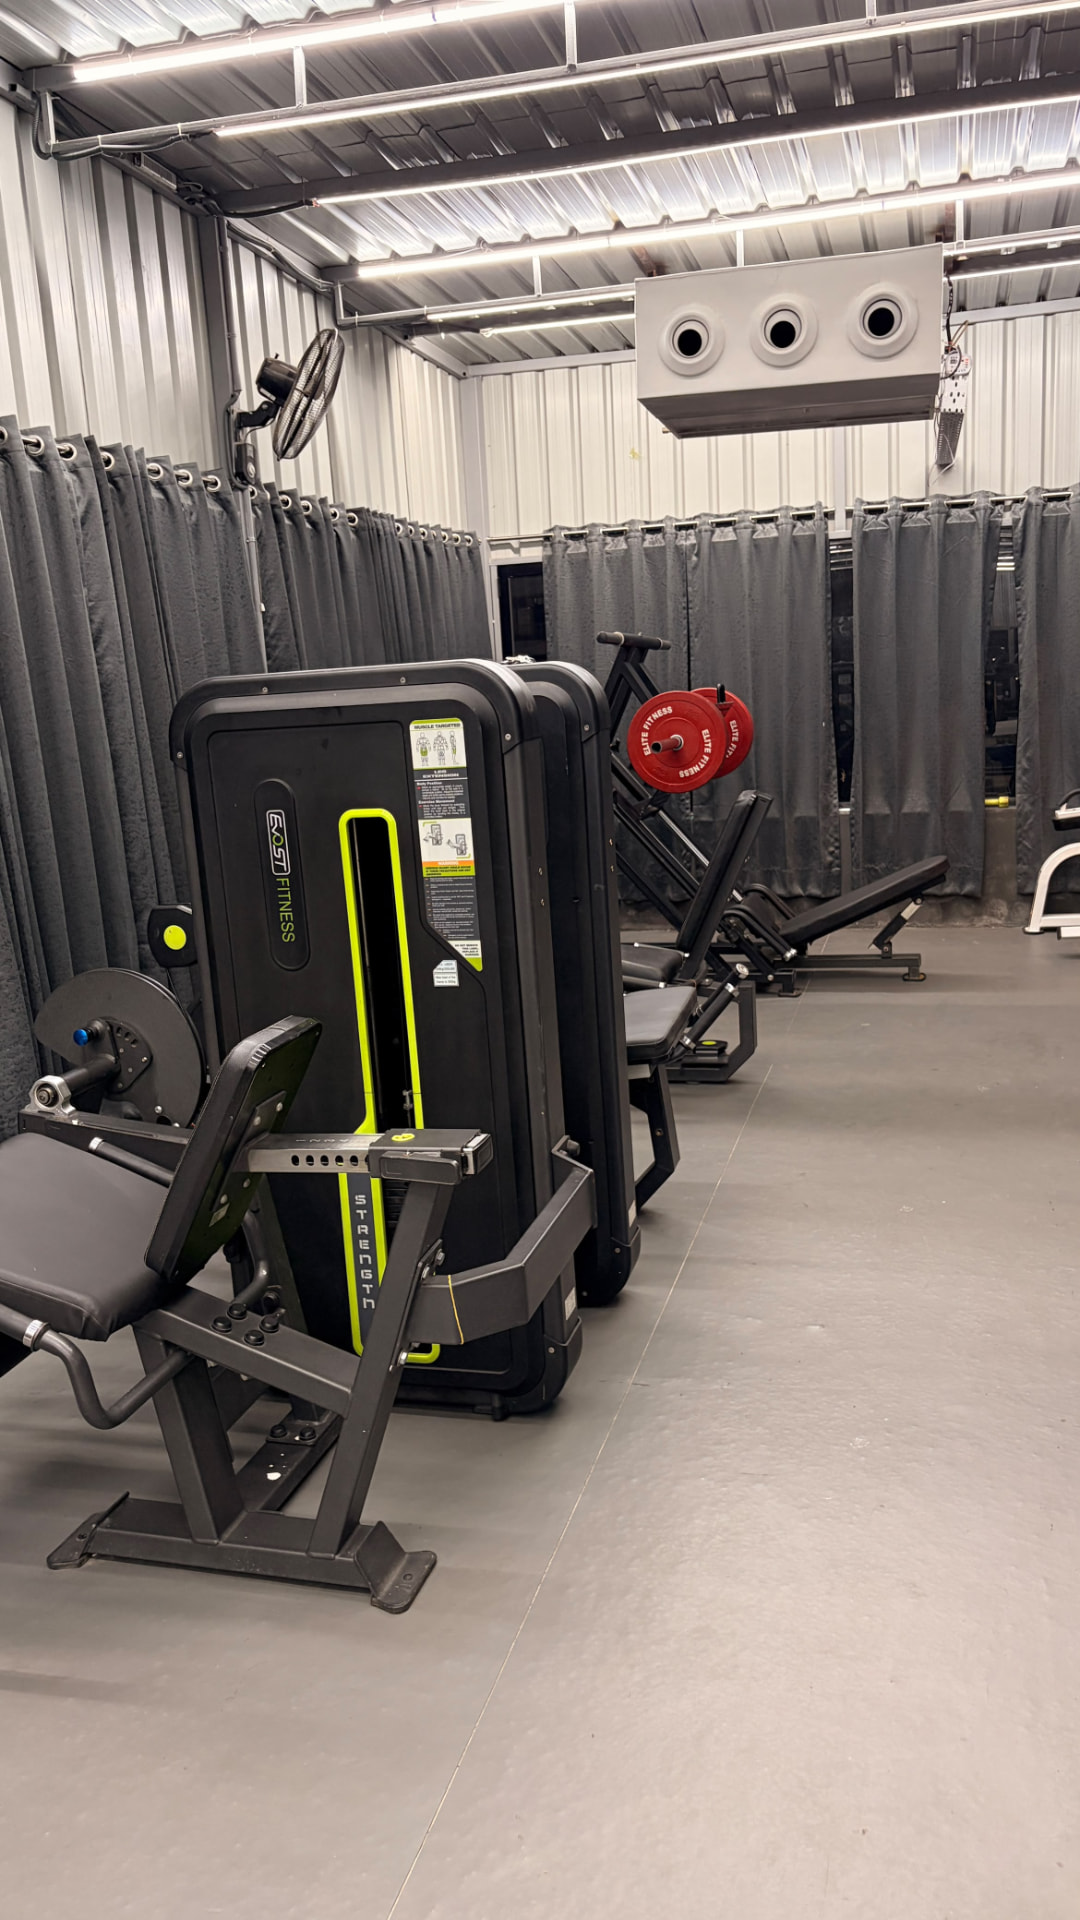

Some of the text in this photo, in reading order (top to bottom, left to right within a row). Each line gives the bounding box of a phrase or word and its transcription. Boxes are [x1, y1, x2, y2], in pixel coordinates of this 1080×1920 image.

[640, 706, 673, 757] ELITE FITNESS
[678, 728, 712, 778] ELITE FITNESS
[729, 719, 739, 742] ELITE
[275, 877, 296, 943] FITNESS
